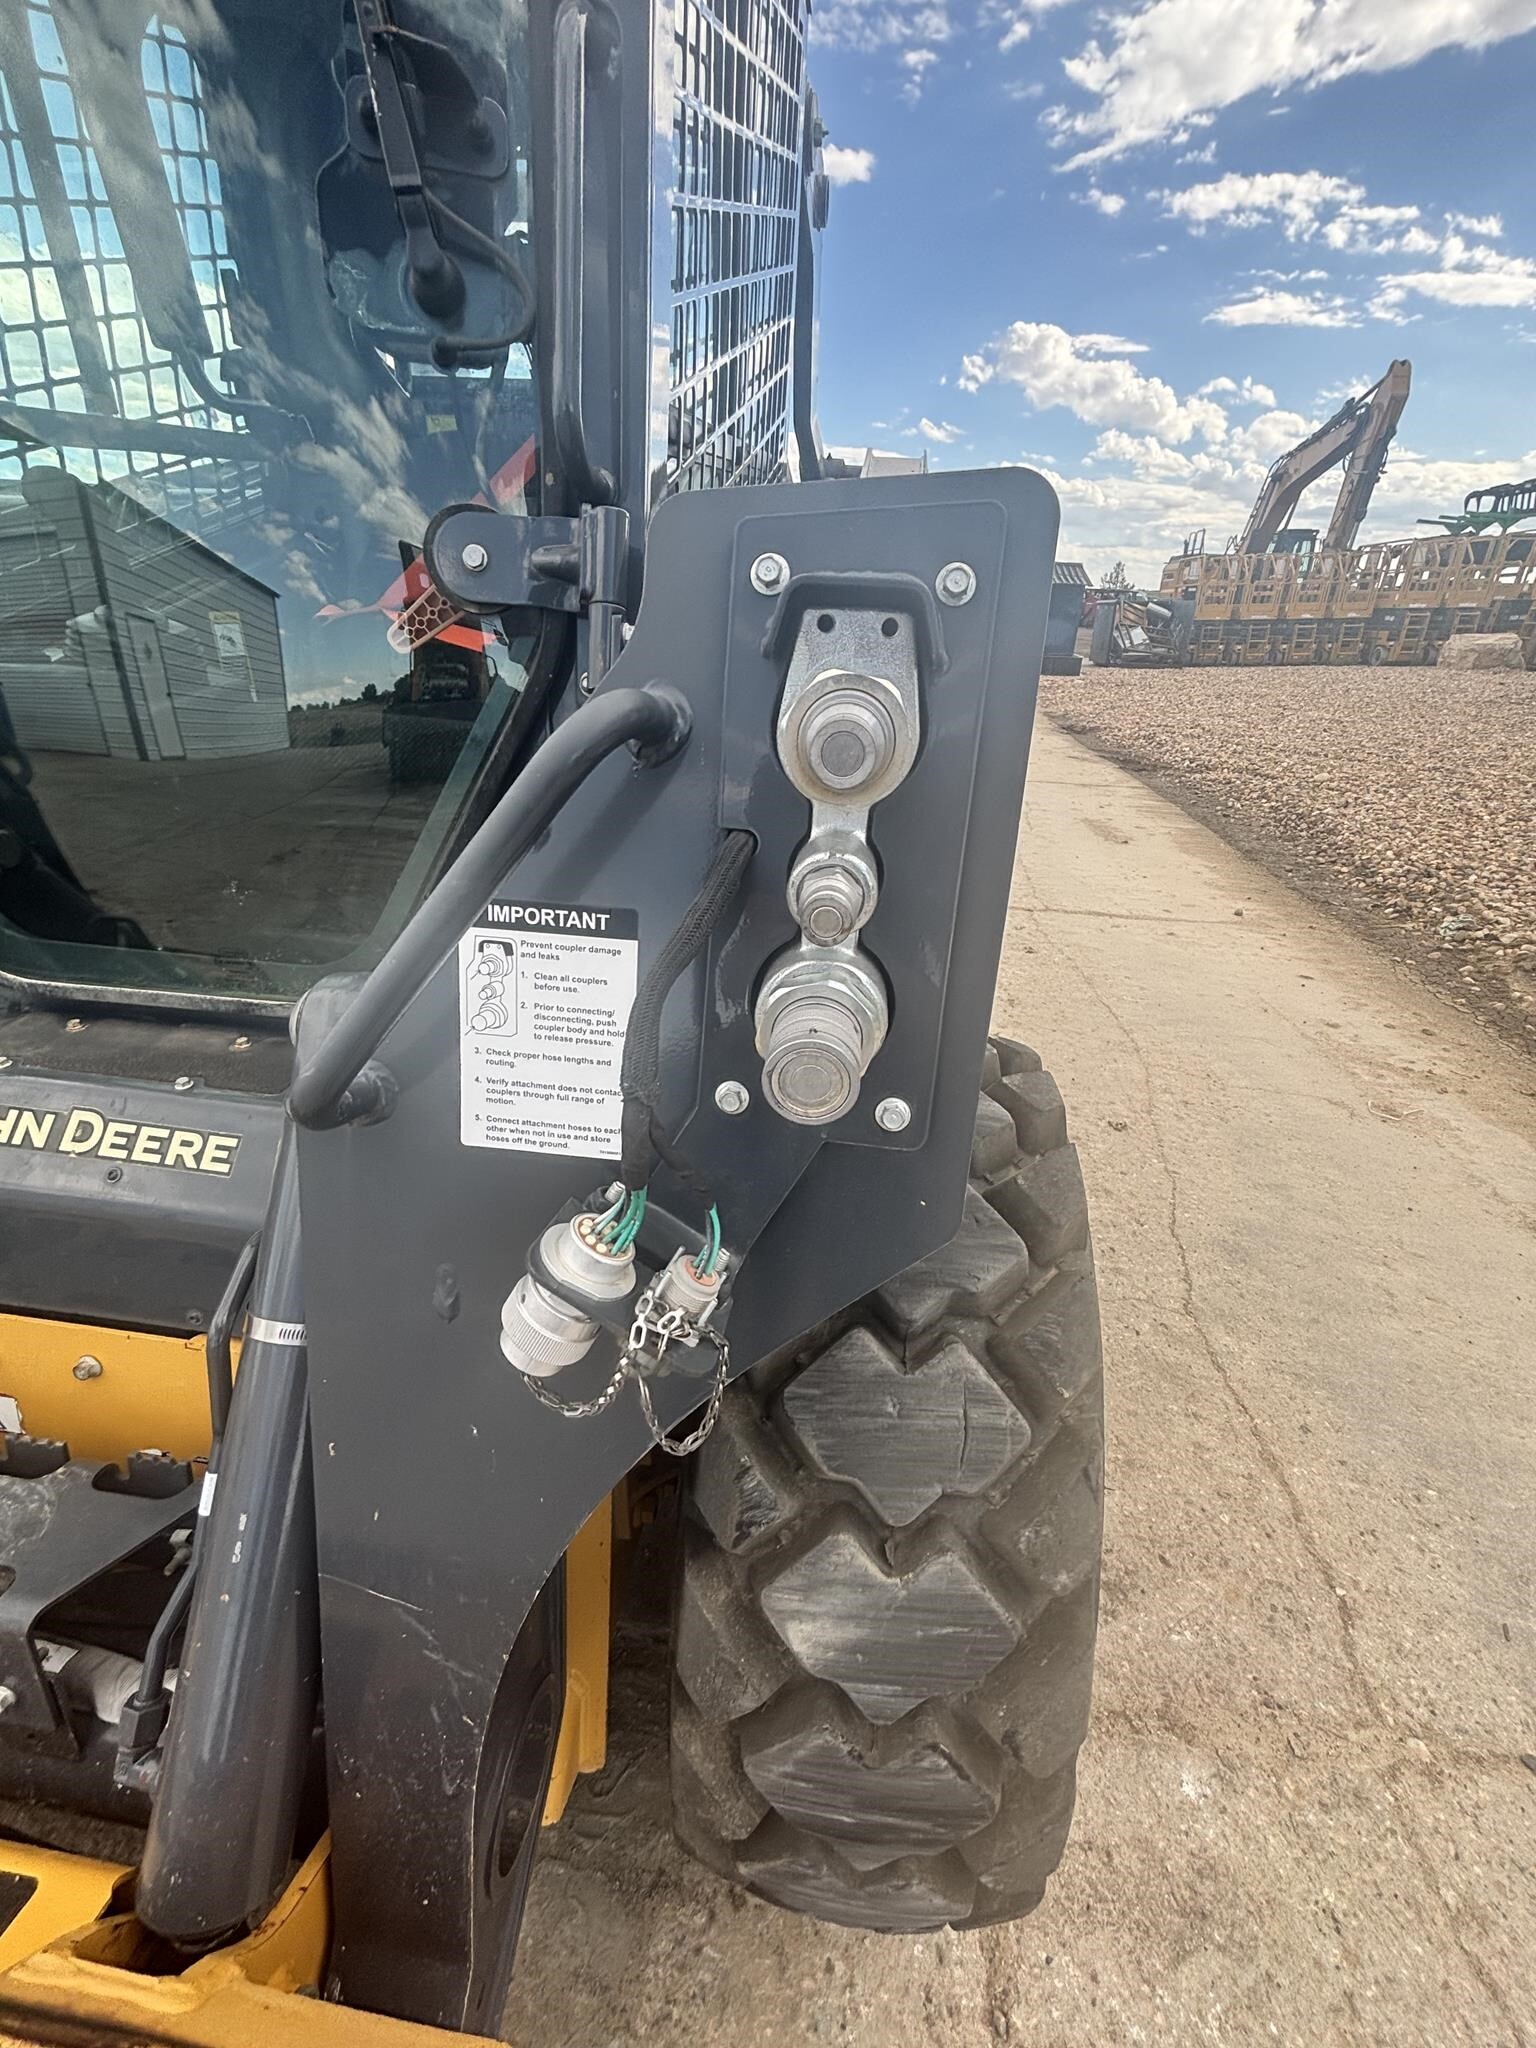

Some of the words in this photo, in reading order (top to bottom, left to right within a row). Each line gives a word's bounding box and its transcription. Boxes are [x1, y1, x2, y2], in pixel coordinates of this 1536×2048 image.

[488, 904, 610, 930] IMPORTANT
[520, 940, 552, 949] Prevent
[554, 943, 586, 953] coupler
[588, 945, 622, 956] damage
[520, 951, 536, 959] and
[538, 952, 560, 961] leaks
[534, 972, 558, 981] Clean
[572, 976, 608, 986] couplers
[534, 982, 560, 992] before
[534, 1002, 554, 1011] Prior
[567, 1007, 615, 1017] connecting/
[534, 1013, 594, 1026] disconnecting,
[596, 1019, 617, 1027] push
[534, 1023, 565, 1033] coupler
[567, 1026, 587, 1036] body
[589, 1028, 605, 1036] and
[607, 1030, 624, 1038] hold
[544, 1035, 573, 1043] release
[576, 1038, 614, 1047] pressure.
[486, 1048, 511, 1058] Check
[513, 1051, 540, 1060] proper
[542, 1054, 562, 1062] hose
[564, 1056, 594, 1065] lengths
[486, 1058, 516, 1068] routing.
[486, 1077, 509, 1087] Verify
[511, 1081, 556, 1091] attachment
[558, 1084, 577, 1092] does
[486, 1088, 521, 1097] couplers
[523, 1090, 554, 1100] through
[557, 1093, 569, 1101] full
[572, 1096, 594, 1104] range
[486, 1097, 515, 1105] motion.
[486, 1115, 519, 1125] Connect
[522, 1119, 566, 1130] attachment
[568, 1123, 591, 1132] hoses
[58, 1109, 238, 1174] DEERE
[525, 1138, 537, 1146] the
[539, 1140, 570, 1149] ground.
[573, 1133, 588, 1141] and
[591, 1135, 611, 1143] store
